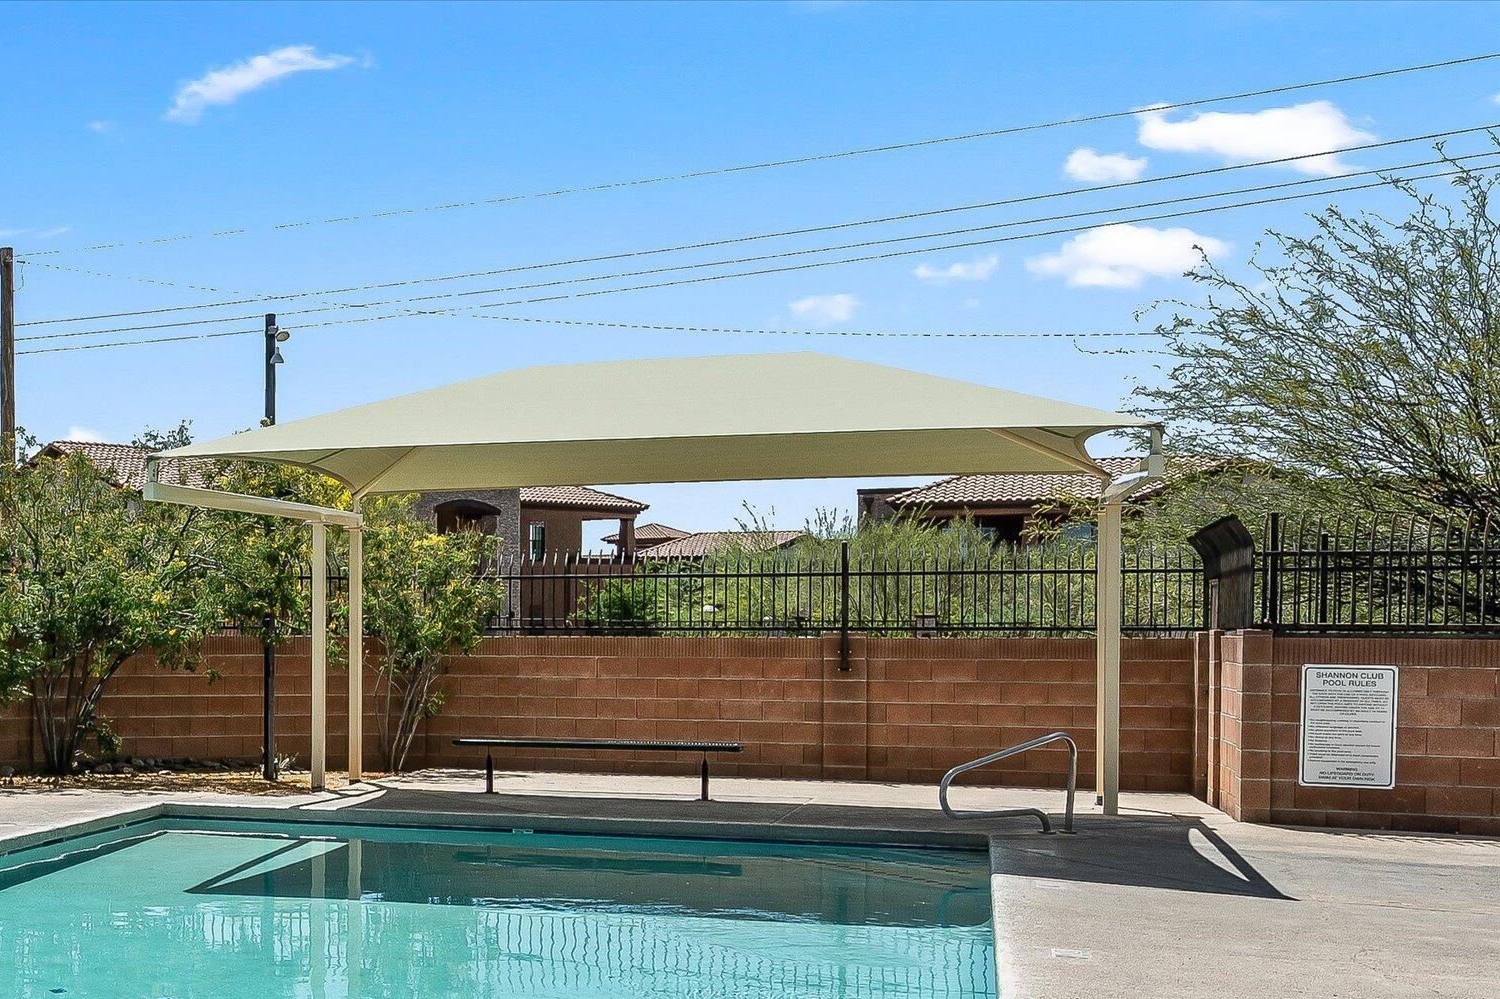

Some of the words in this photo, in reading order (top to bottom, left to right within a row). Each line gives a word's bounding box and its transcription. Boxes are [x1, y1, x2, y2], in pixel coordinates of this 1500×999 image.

[1316, 671, 1358, 679] SHANNON
[1360, 672, 1384, 680] CLUB
[1322, 679, 1346, 687] POOL
